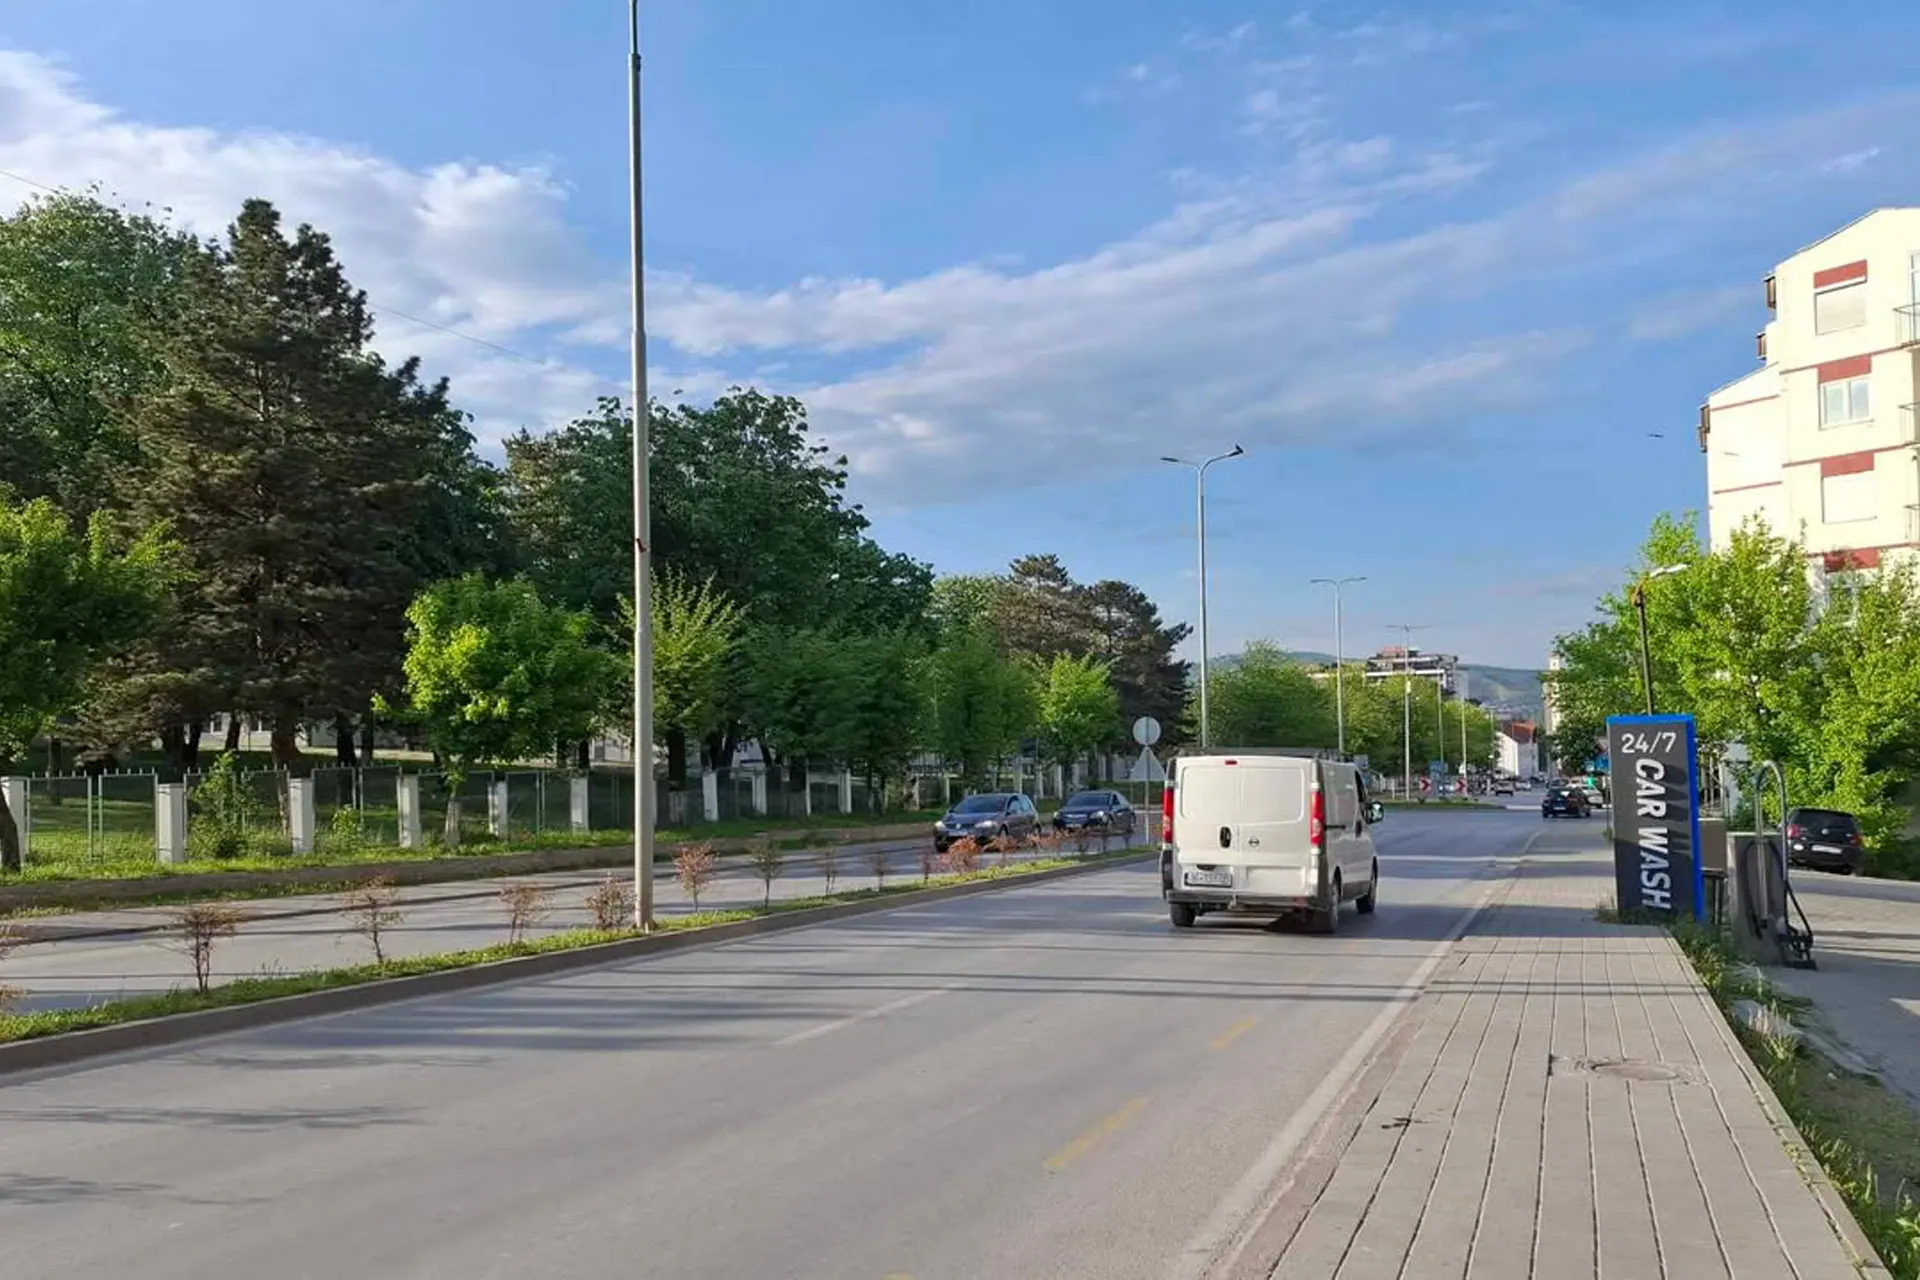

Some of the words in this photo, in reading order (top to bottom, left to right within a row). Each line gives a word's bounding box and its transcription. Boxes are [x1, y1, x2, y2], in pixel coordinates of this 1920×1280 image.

[1621, 732, 1676, 753] 24/7
[1636, 758, 1666, 818] CAR
[1638, 827, 1672, 909] WASH
